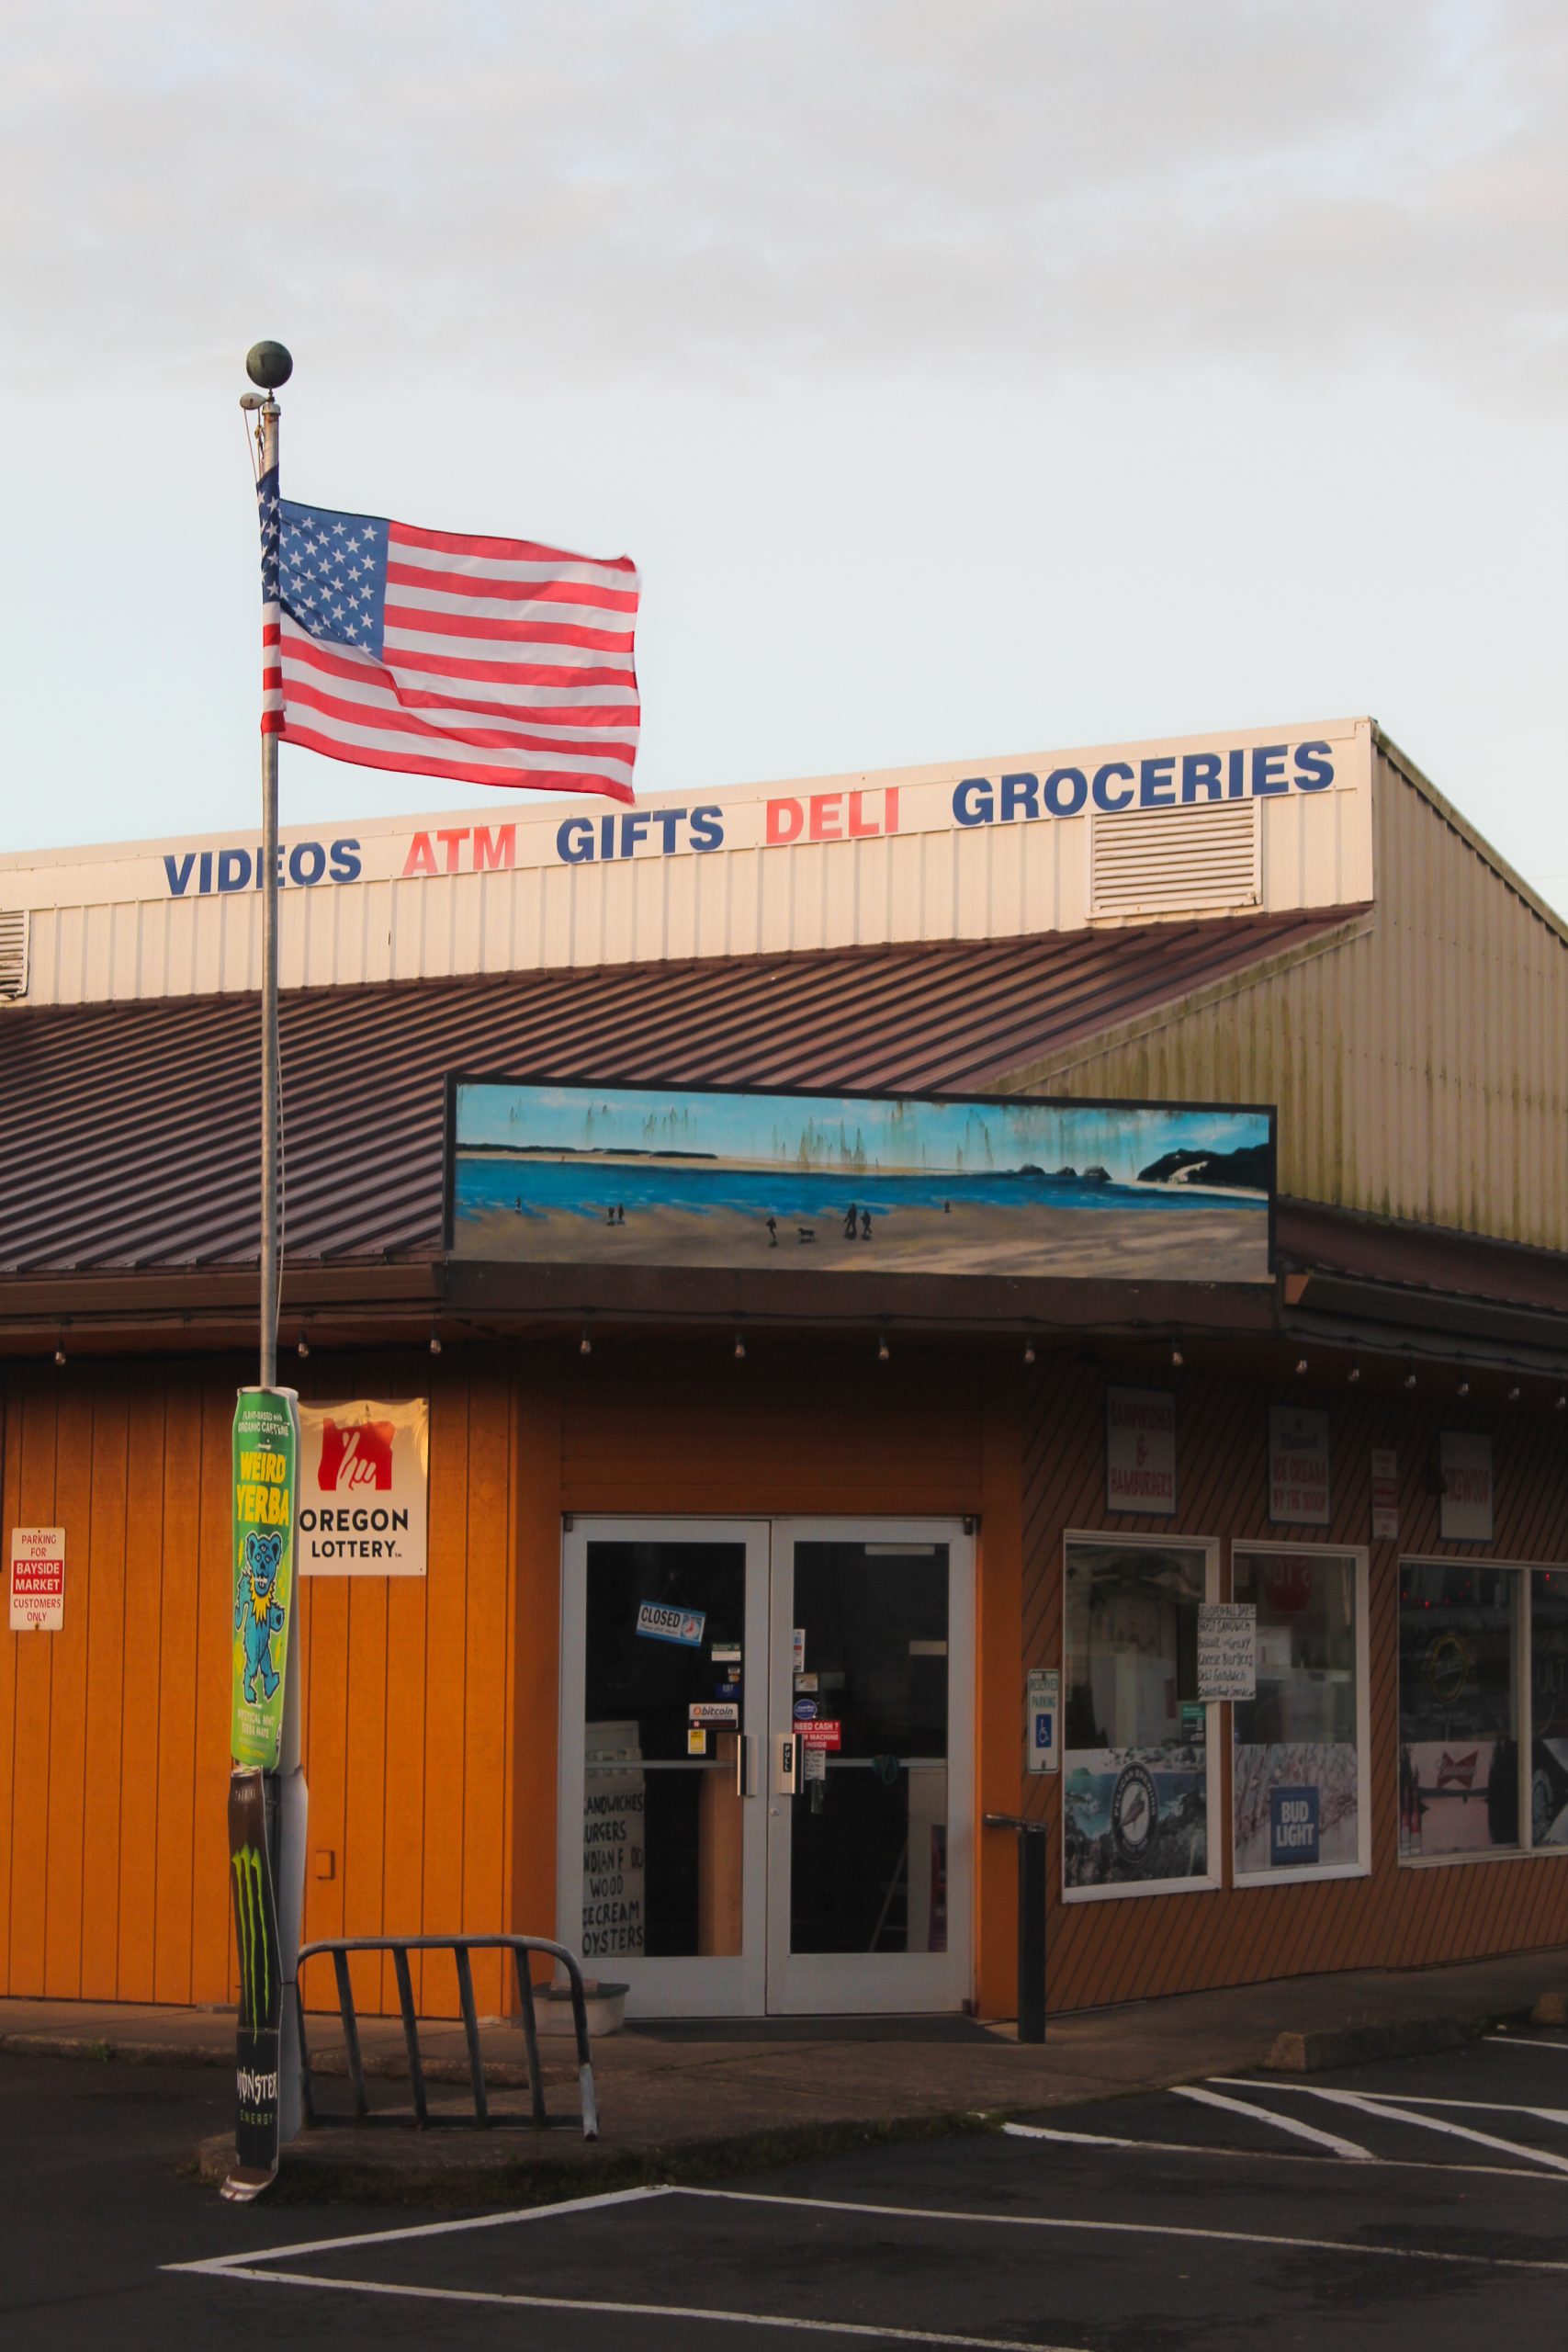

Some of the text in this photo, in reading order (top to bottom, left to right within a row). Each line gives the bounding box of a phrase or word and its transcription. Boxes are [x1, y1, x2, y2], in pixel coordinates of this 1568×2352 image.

[402, 824, 516, 877] ATM
[556, 805, 724, 864] GIFTS
[766, 786, 899, 845] DELI
[952, 741, 1335, 826] GROCERIES
[241, 1451, 286, 1484] WEIRD
[236, 1485, 289, 1526] YERBA
[299, 1509, 409, 1532] OREGON
[21, 1534, 57, 1544] PARKING
[311, 1540, 396, 1558] LOTTERY
[30, 1547, 47, 1557] FOR
[17, 1562, 60, 1575] BAYSIDE
[16, 1578, 60, 1591] MARKET
[14, 1599, 62, 1609] CUSTOMERS
[27, 1611, 47, 1623] ONLY
[641, 1606, 681, 1628] CLOSED
[1029, 1679, 1058, 1690] RESERVED
[702, 1705, 734, 1717] bitcoin
[1032, 1696, 1056, 1707] PARKING
[794, 1722, 813, 1731] NEED
[814, 1722, 834, 1731] CASH
[1280, 1800, 1309, 1824] BUD
[584, 1820, 626, 1844] URGERS
[1276, 1823, 1314, 1847] LIGHT
[583, 1849, 615, 1872] NDIAN
[590, 1875, 624, 1898] WOOD
[582, 1926, 643, 1955] OYSTERS
[236, 2065, 278, 2106] MONSTER
[240, 2109, 274, 2125] ENERGY
